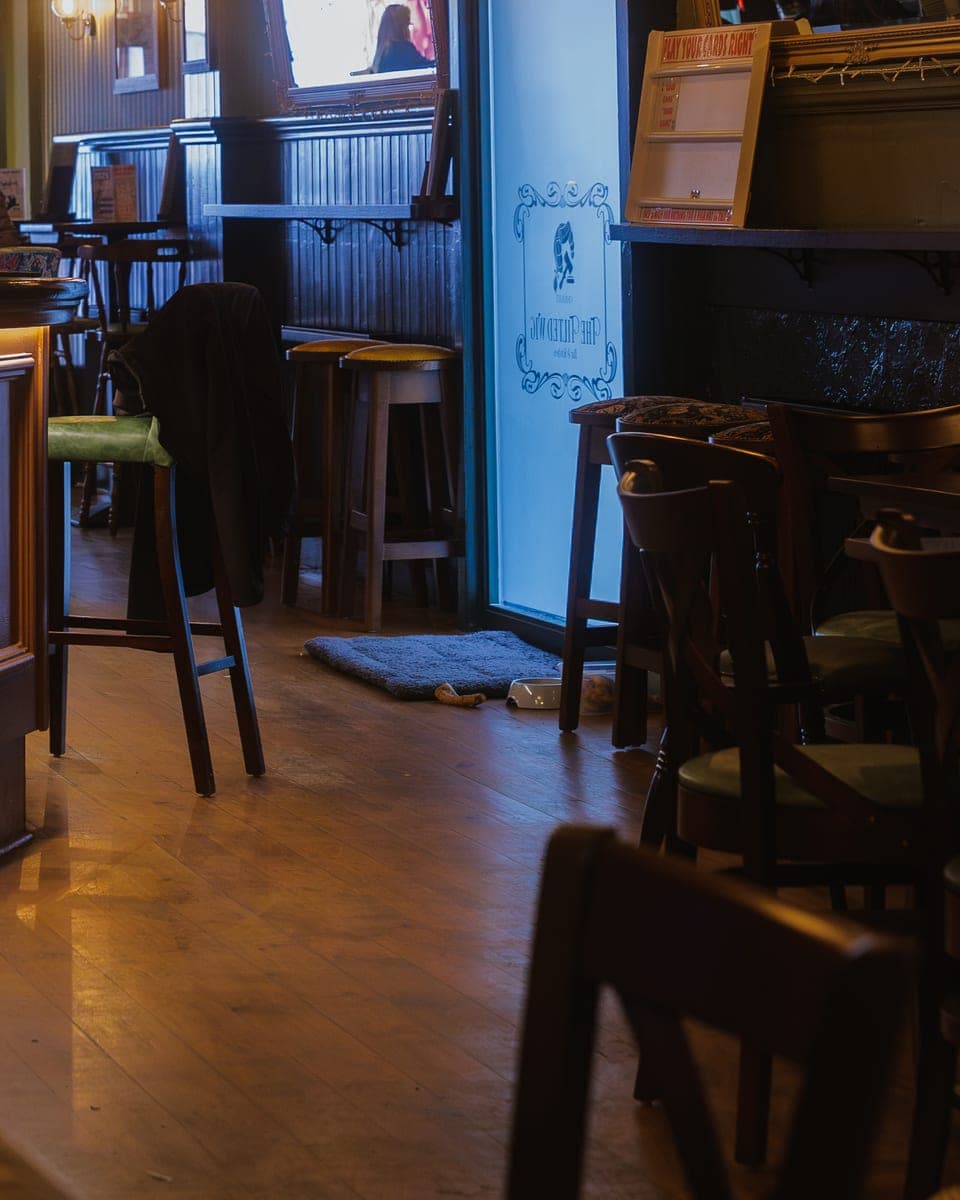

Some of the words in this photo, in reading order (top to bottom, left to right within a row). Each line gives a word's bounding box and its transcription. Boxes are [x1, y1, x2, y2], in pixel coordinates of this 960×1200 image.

[681, 35, 702, 60] YOUR
[702, 33, 729, 58] CARDS
[729, 31, 754, 56] RIGHT
